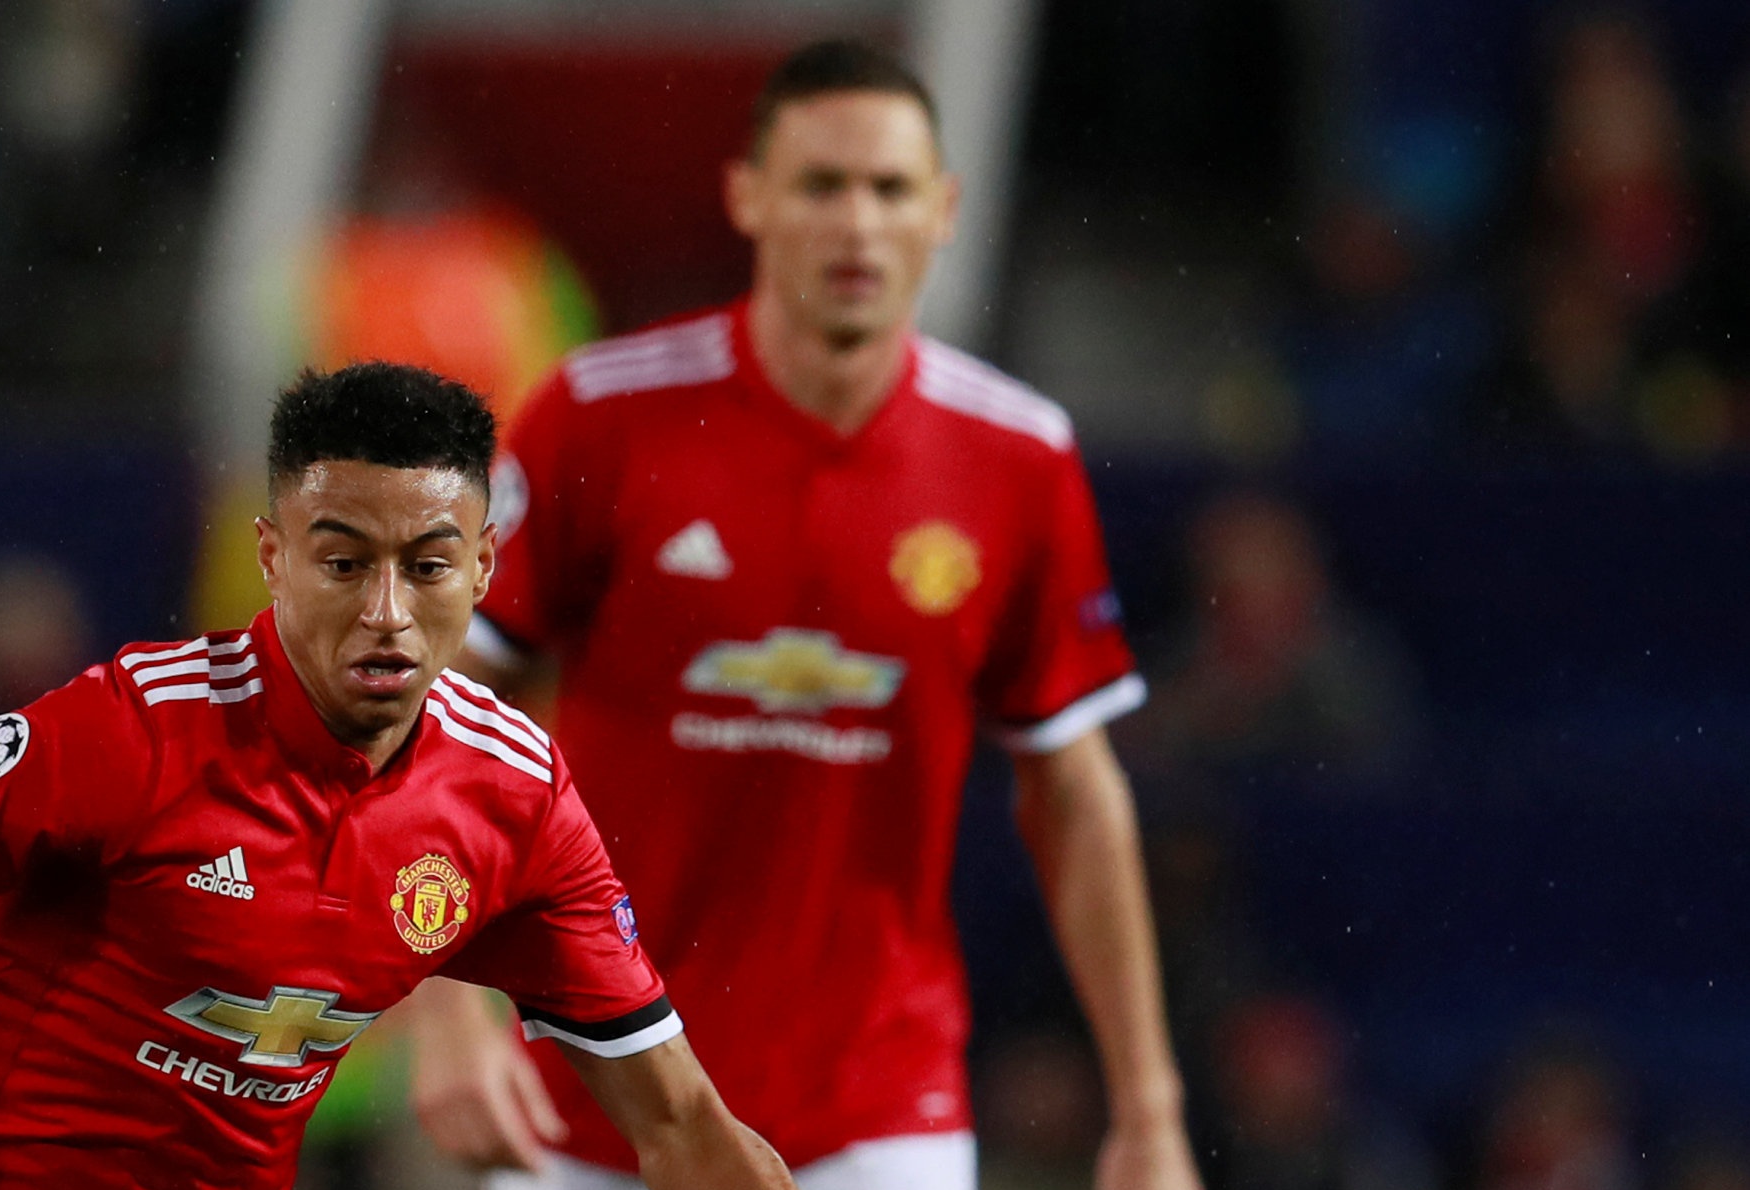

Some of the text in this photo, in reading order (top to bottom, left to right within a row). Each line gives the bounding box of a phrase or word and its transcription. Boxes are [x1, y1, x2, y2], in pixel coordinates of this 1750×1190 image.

[186, 872, 255, 900] adidas
[401, 861, 463, 898] MANCHESTER
[404, 927, 446, 947] UNITED
